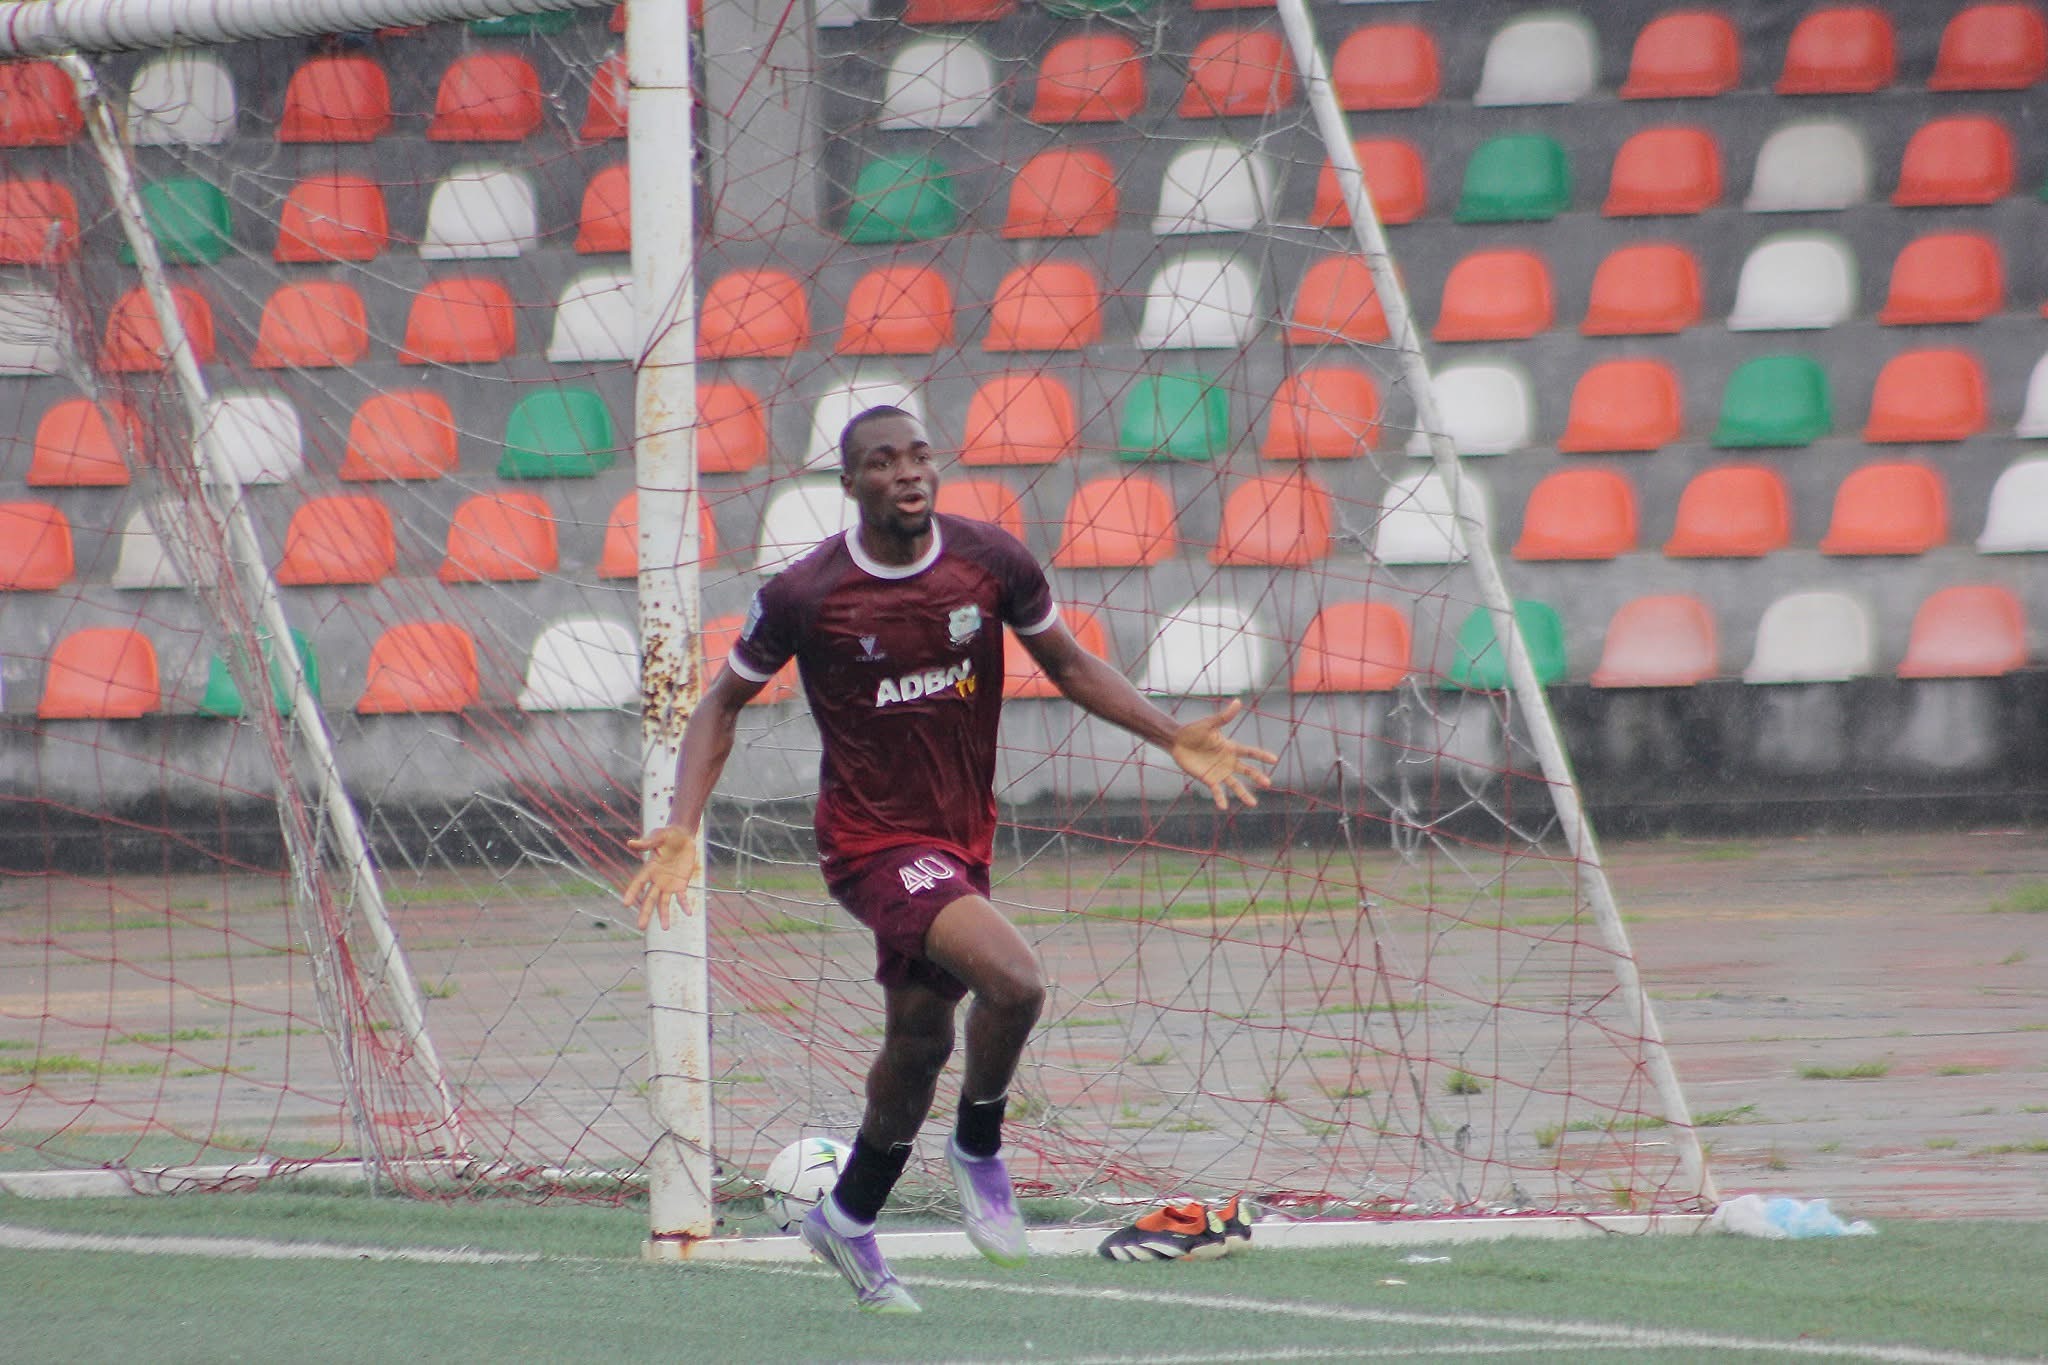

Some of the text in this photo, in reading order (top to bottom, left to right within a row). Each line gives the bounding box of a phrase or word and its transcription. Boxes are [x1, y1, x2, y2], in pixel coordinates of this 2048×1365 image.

[875, 658, 972, 708] ADBN
[955, 674, 976, 698] TV
[898, 856, 954, 894] 40
